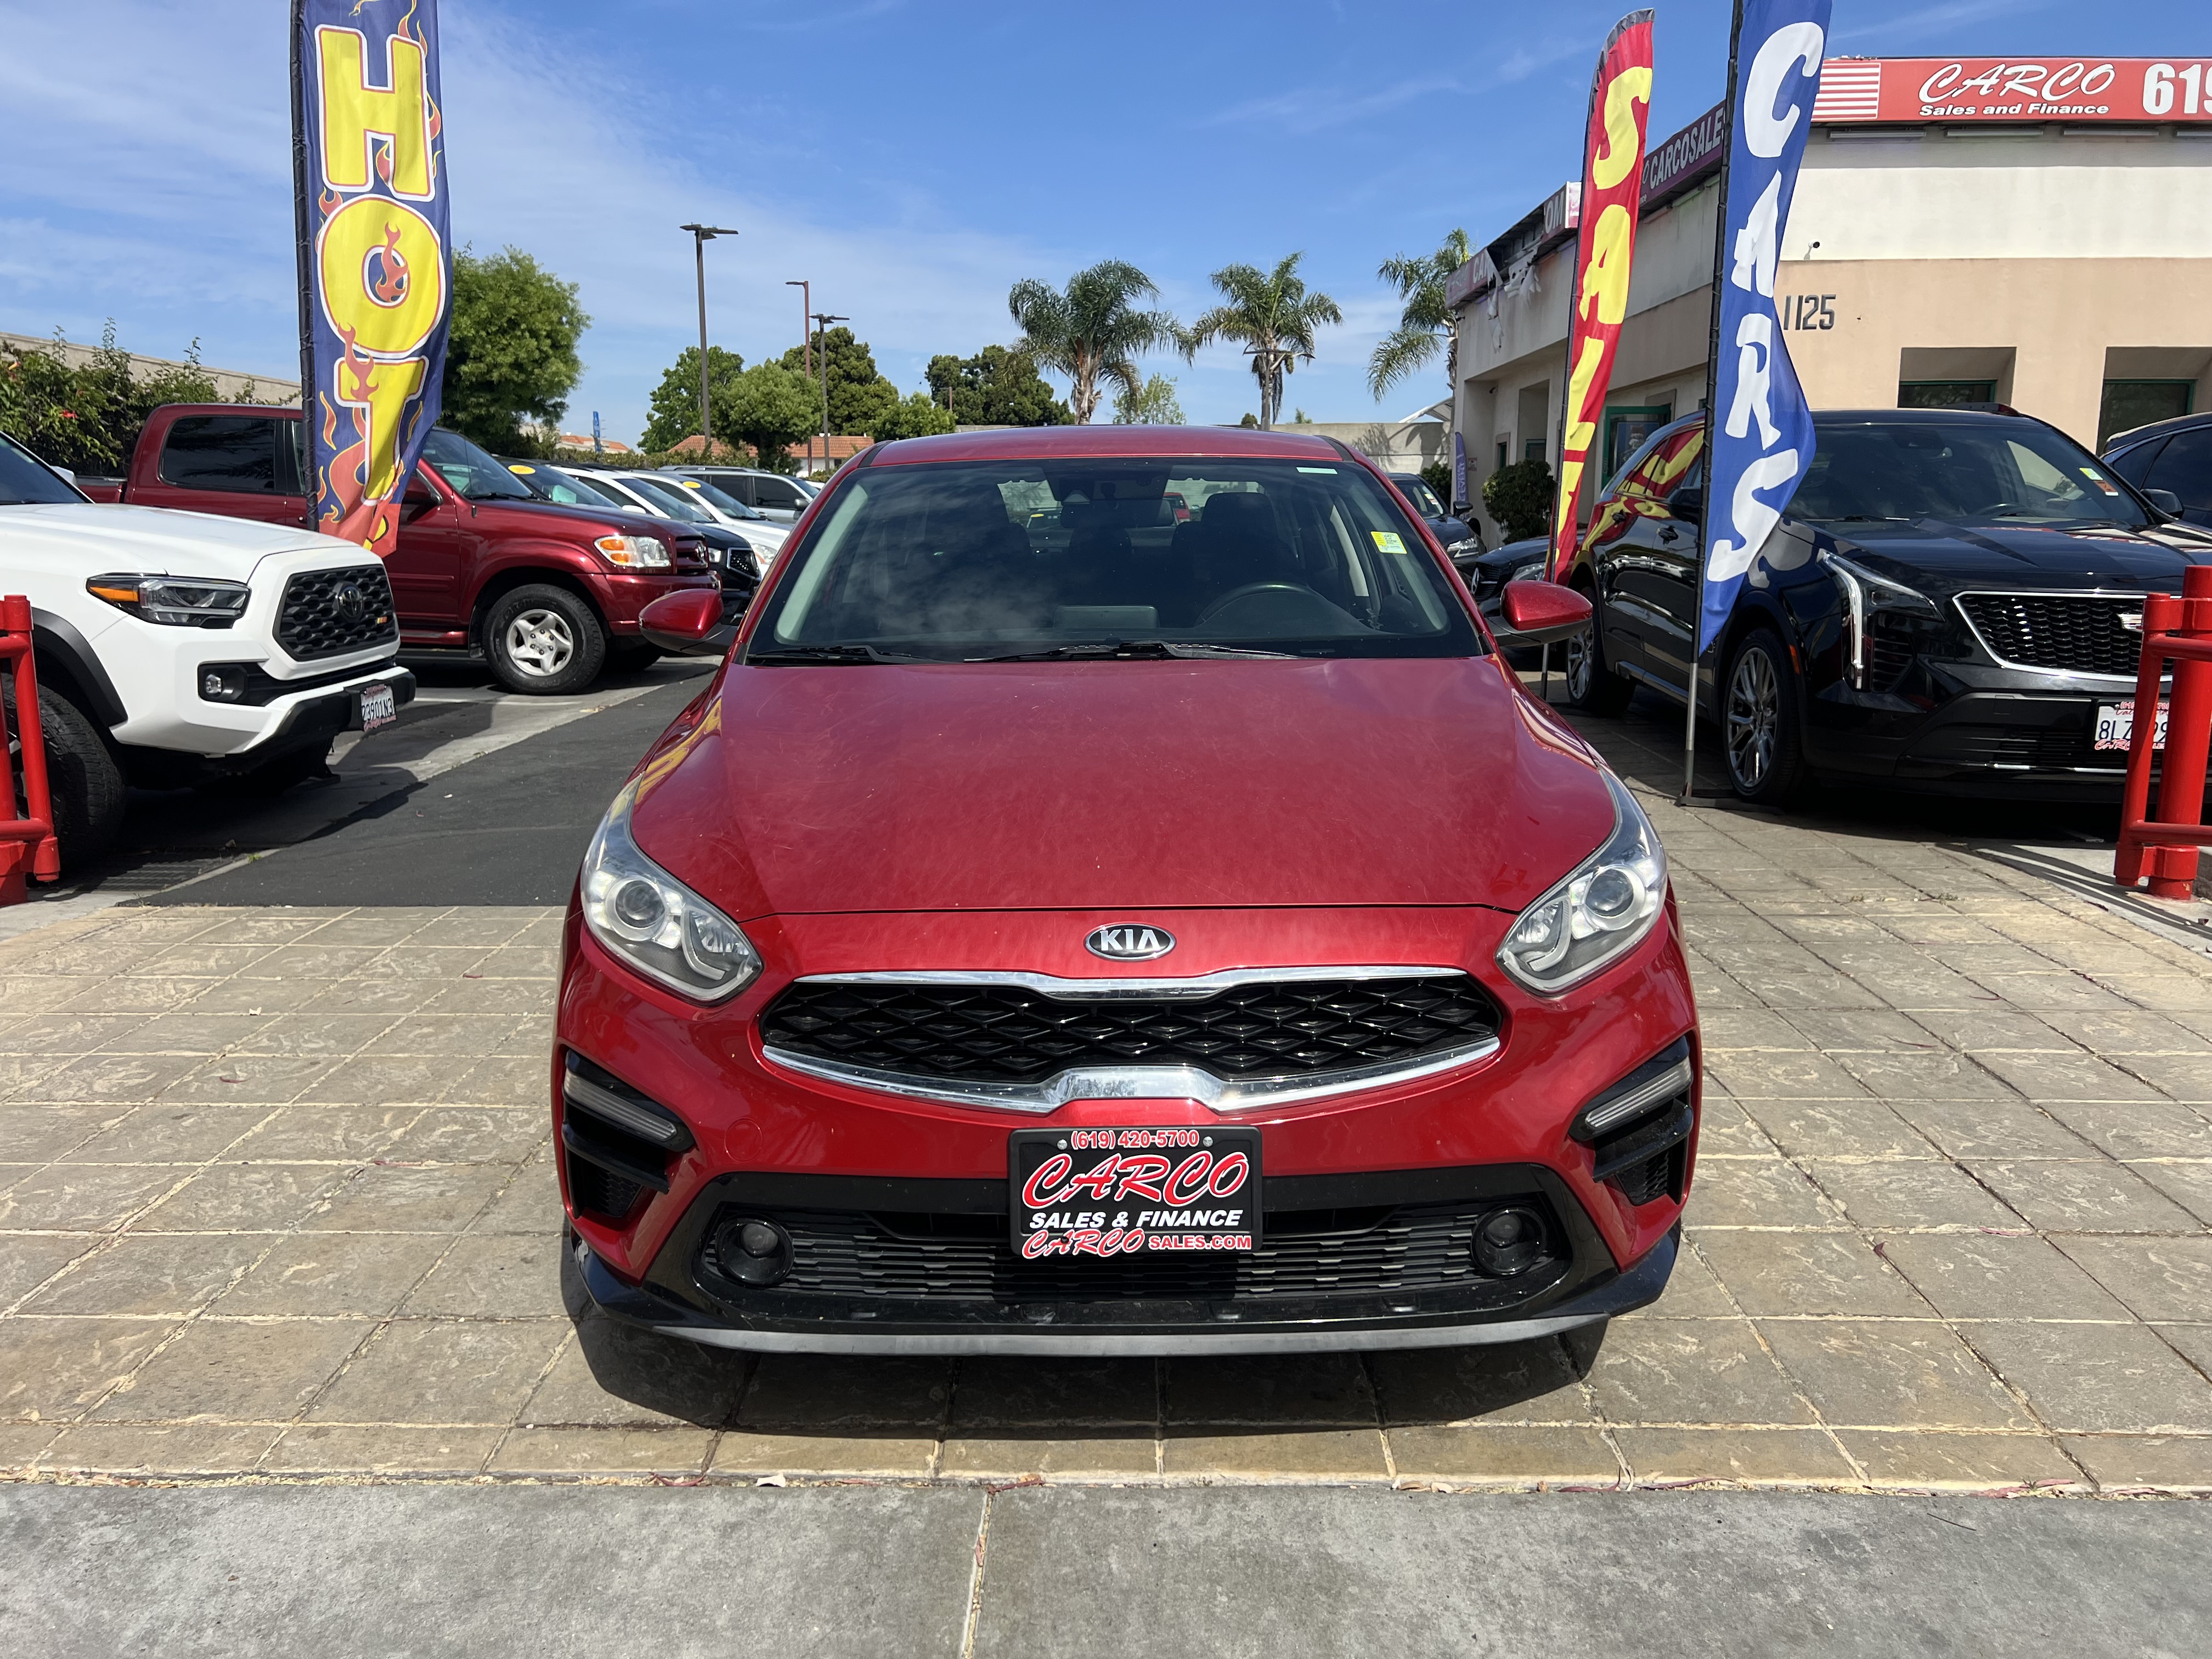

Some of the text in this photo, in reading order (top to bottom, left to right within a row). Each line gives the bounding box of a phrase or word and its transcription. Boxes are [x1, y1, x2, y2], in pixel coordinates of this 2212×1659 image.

[1918, 62, 2115, 103] CARCO
[2142, 63, 2212, 115] 61
[1920, 103, 2109, 116] Sales and Finance
[1650, 107, 1726, 189] CARCOSALE
[314, 24, 446, 506] HOT
[1707, 22, 1825, 583] CARS
[1784, 294, 1836, 330] 1125
[1099, 929, 1161, 951] KIA
[1071, 1130, 1199, 1150] (619) 420-5700
[1022, 1151, 1249, 1209] CARCO
[1029, 1210, 1243, 1228] SALES & FINANCE
[1022, 1228, 1252, 1259] CARCO SALES.COM
